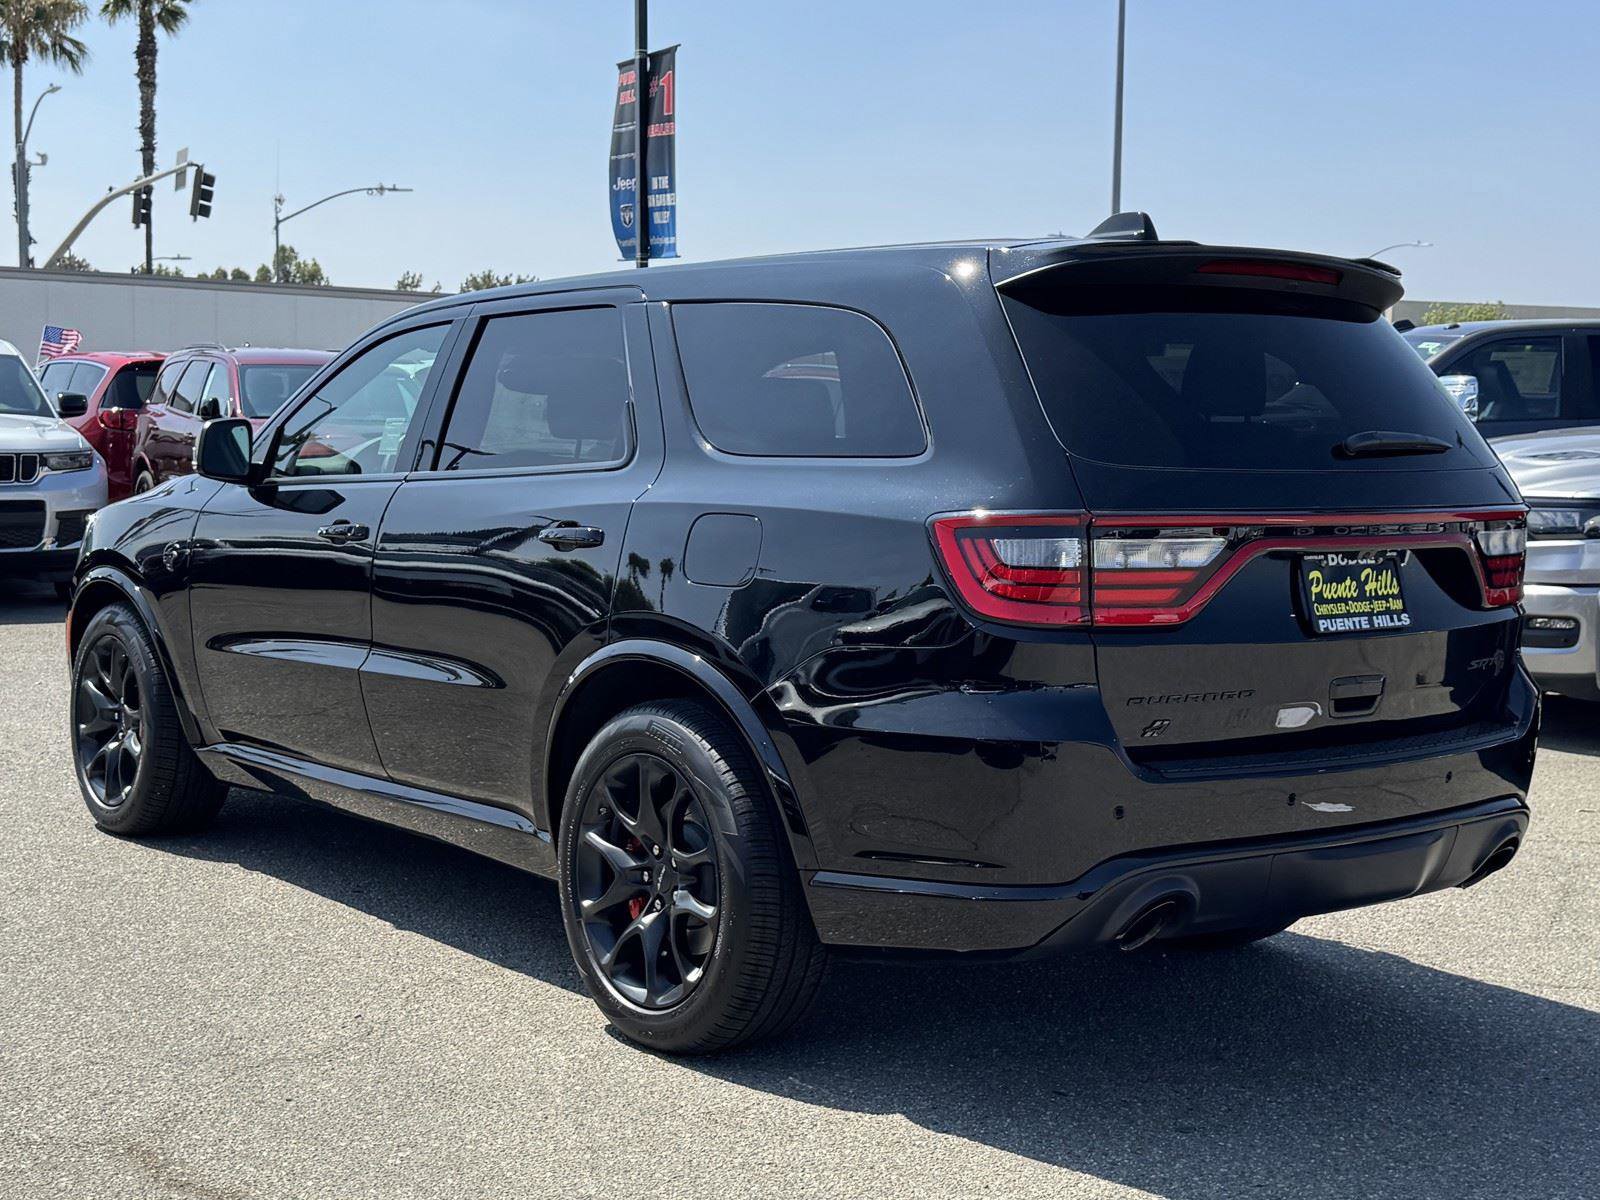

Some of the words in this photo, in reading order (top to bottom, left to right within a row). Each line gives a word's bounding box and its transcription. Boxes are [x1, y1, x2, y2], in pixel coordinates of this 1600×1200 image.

[1308, 570, 1358, 601] Puente
[1361, 567, 1400, 597] Hills
[1319, 616, 1370, 632] PUENTE
[1374, 613, 1411, 629] HILLS
[1126, 689, 1257, 707] DURANGO
